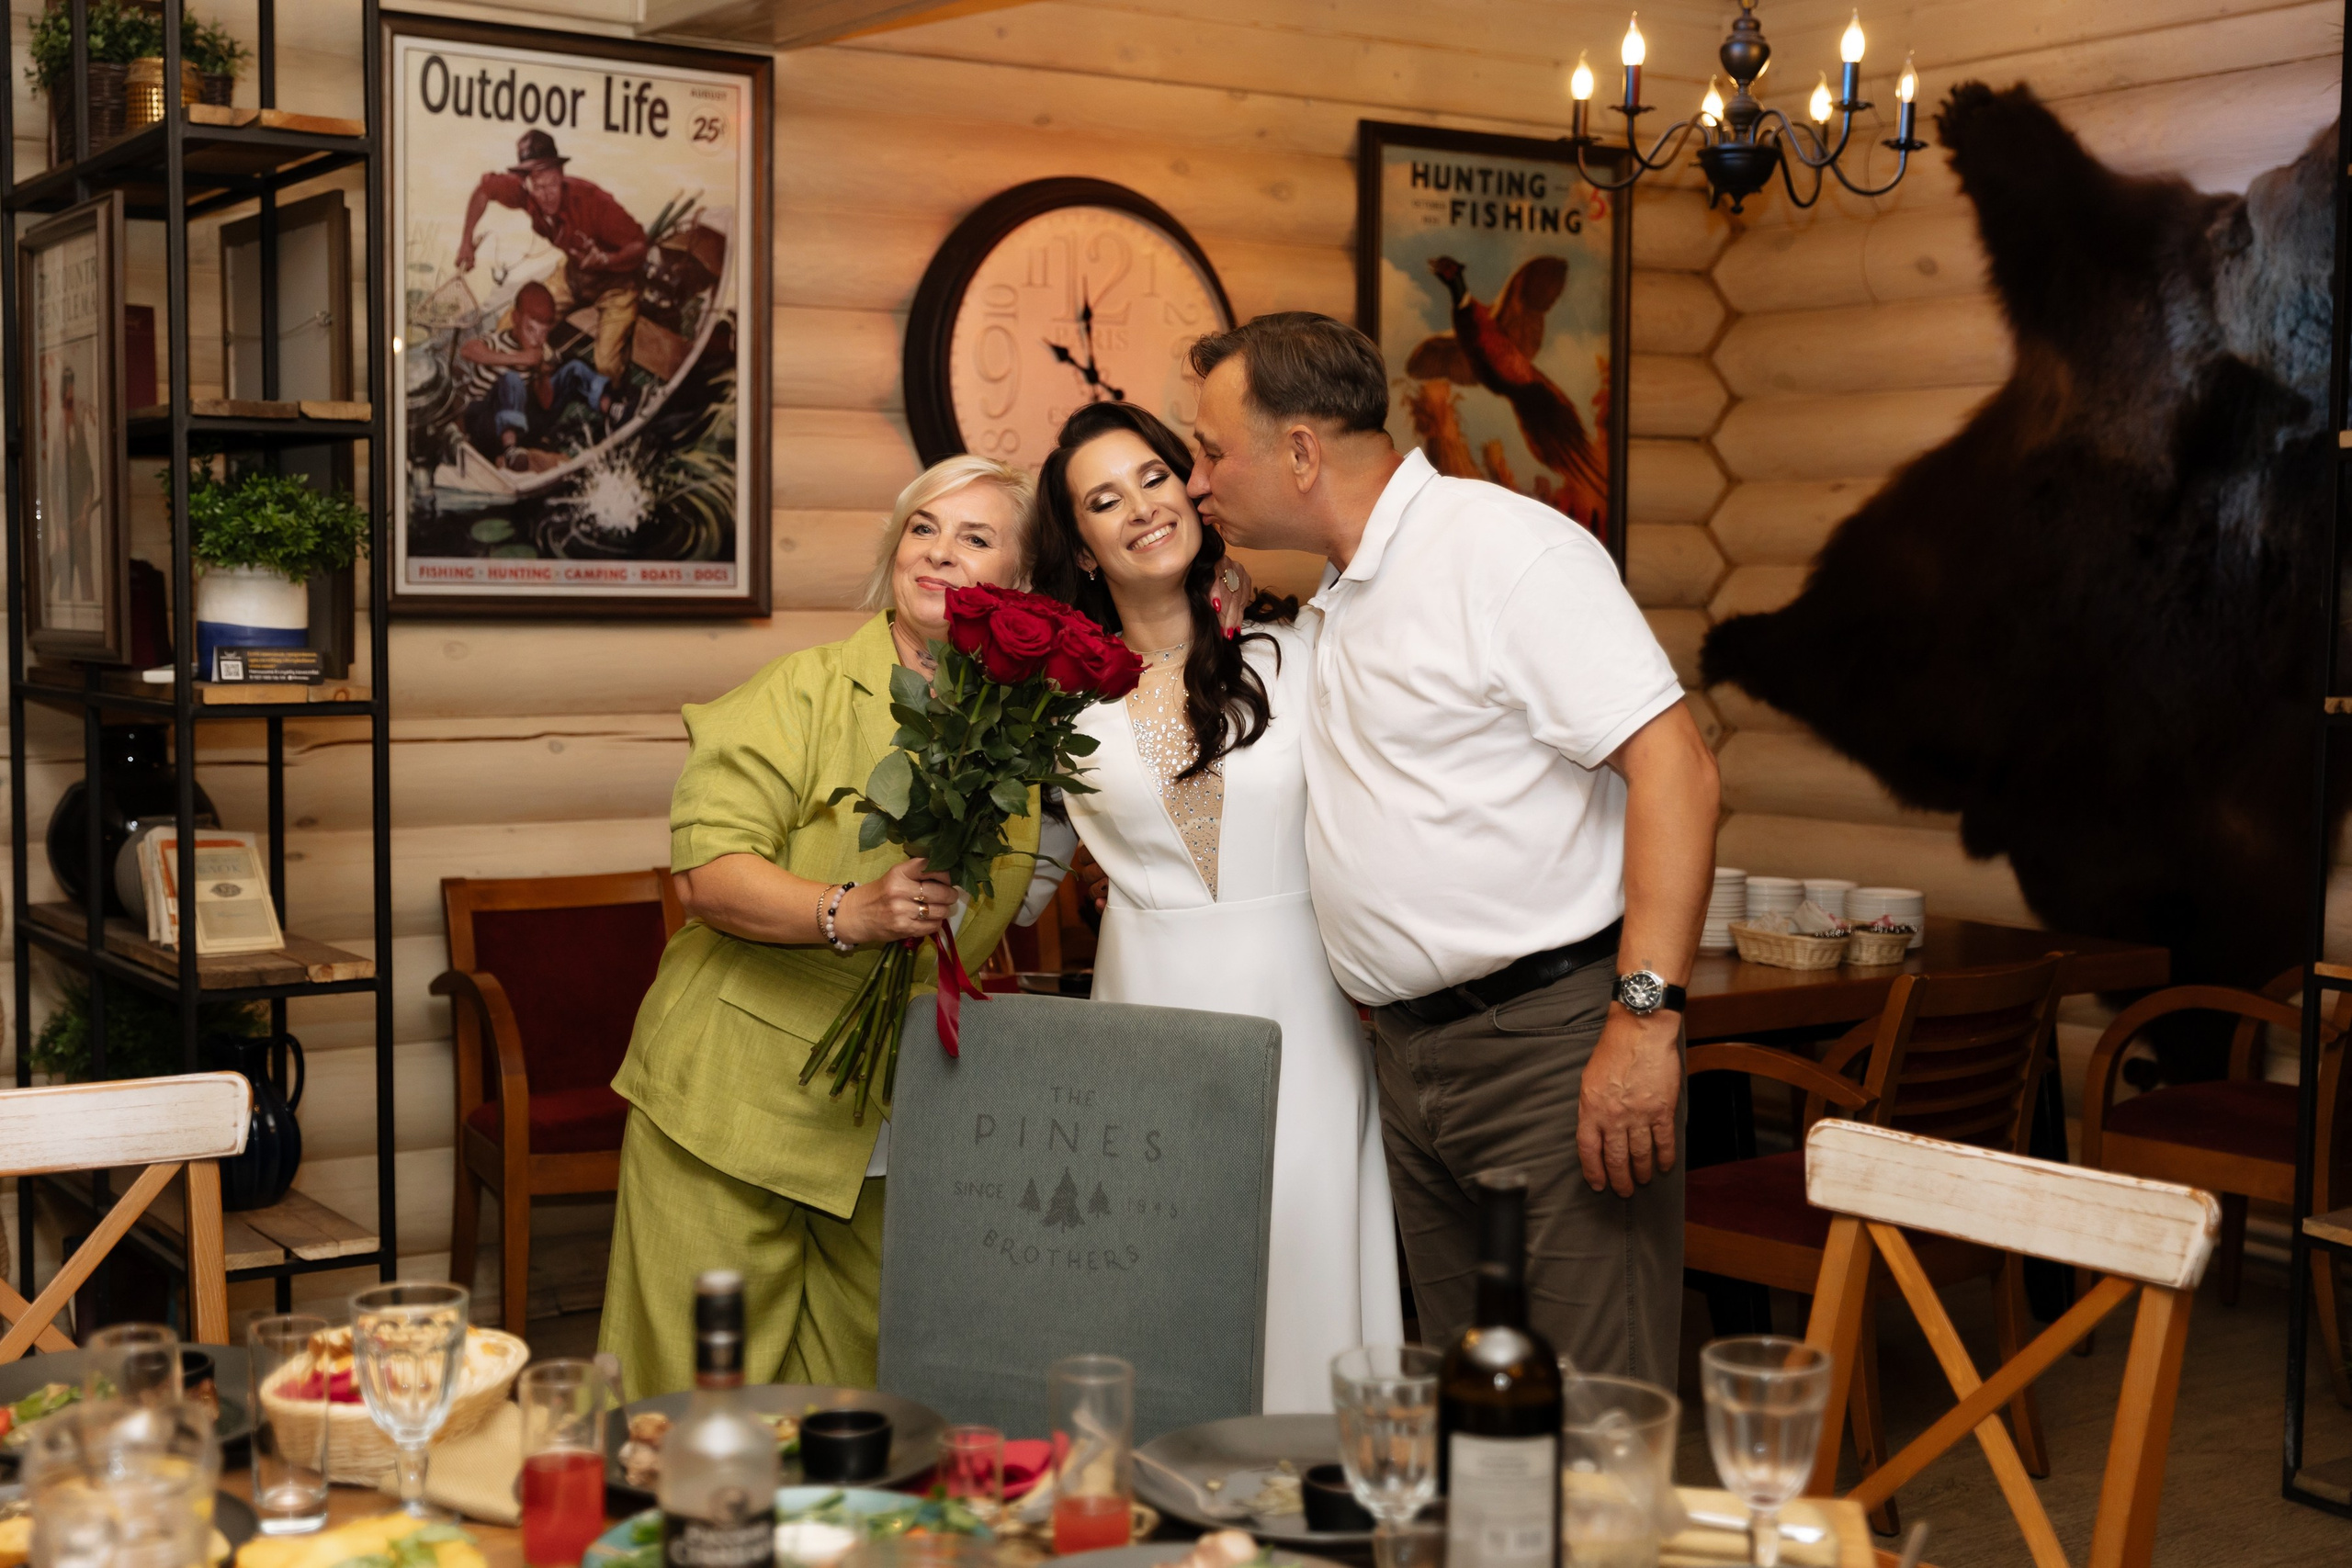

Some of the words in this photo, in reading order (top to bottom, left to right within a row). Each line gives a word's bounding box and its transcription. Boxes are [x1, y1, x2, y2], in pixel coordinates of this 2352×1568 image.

[420, 54, 586, 129] Outdoor
[604, 75, 671, 140] Life
[1410, 161, 1547, 199] HUNTING
[1449, 199, 1582, 236] FISHING
[418, 565, 475, 581] FISHING
[487, 566, 551, 581] HUNTING
[564, 567, 628, 581] CAMPING
[640, 568, 683, 582] BOATS
[693, 568, 729, 582] DOGS
[1050, 1086, 1097, 1108] THE
[974, 1113, 1163, 1163] PINES
[953, 1180, 1004, 1201] SINCE
[982, 1228, 1141, 1271] BROTHERS
